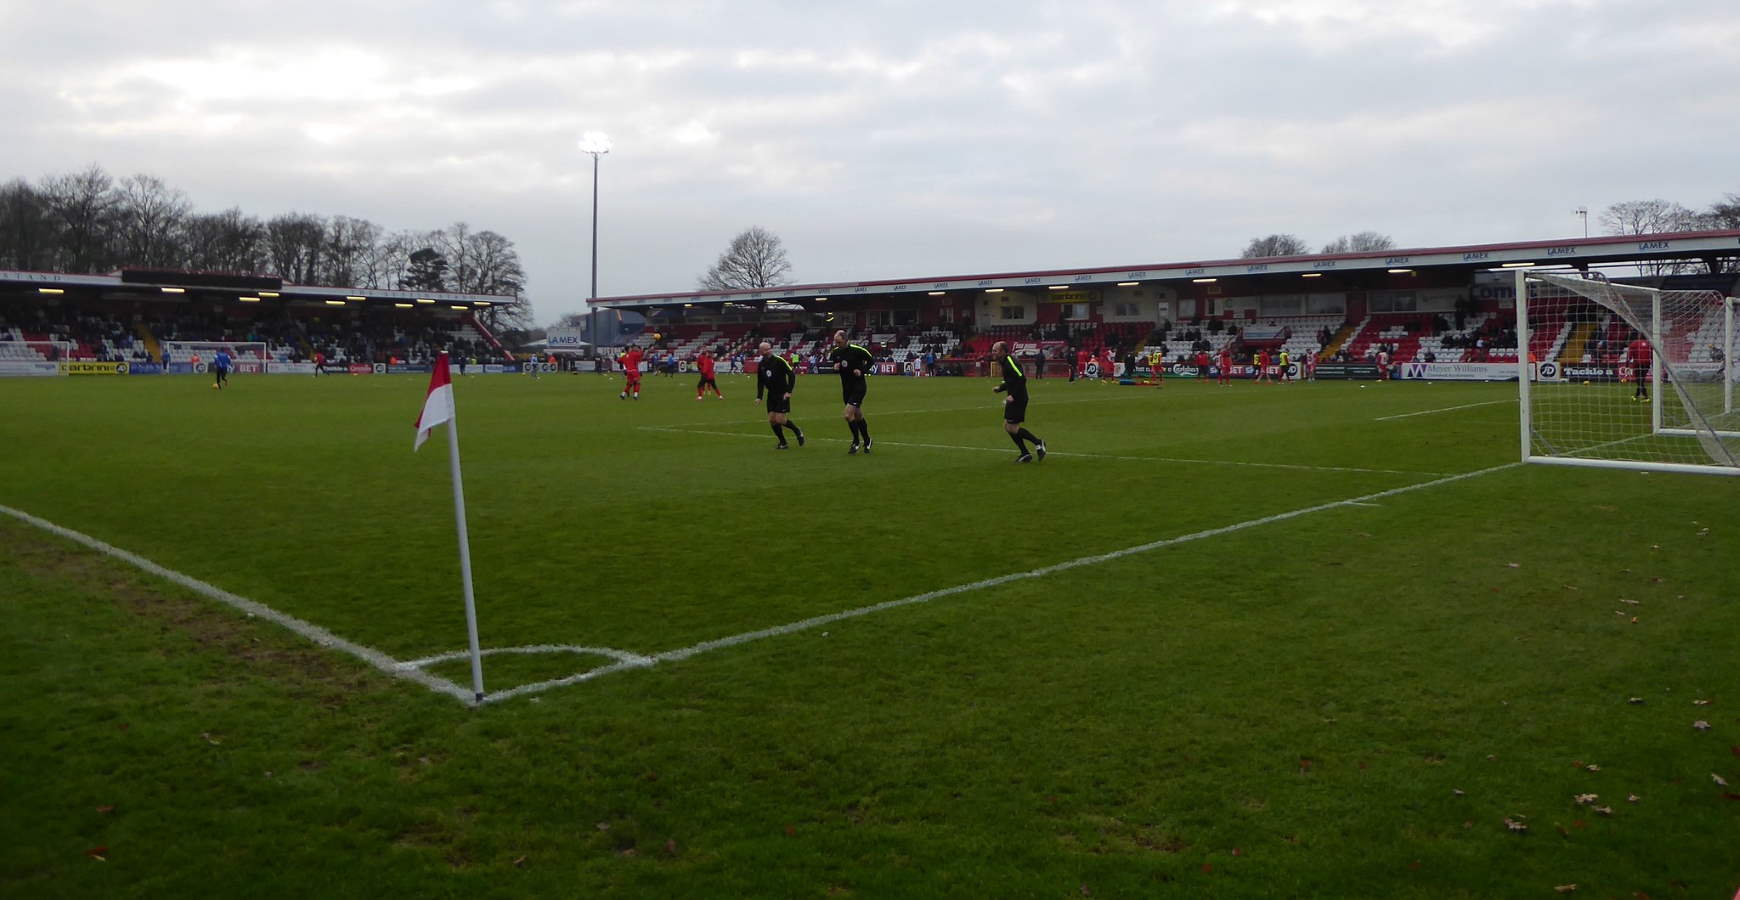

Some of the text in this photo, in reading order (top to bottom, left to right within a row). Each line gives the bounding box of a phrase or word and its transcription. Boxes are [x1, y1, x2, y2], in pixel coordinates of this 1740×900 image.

[1639, 241, 1670, 250] LAMEX
[1463, 252, 1488, 261] LAMEX
[1548, 248, 1576, 256] LAMEX
[549, 336, 577, 344] LAMEX
[881, 364, 896, 373] BET
